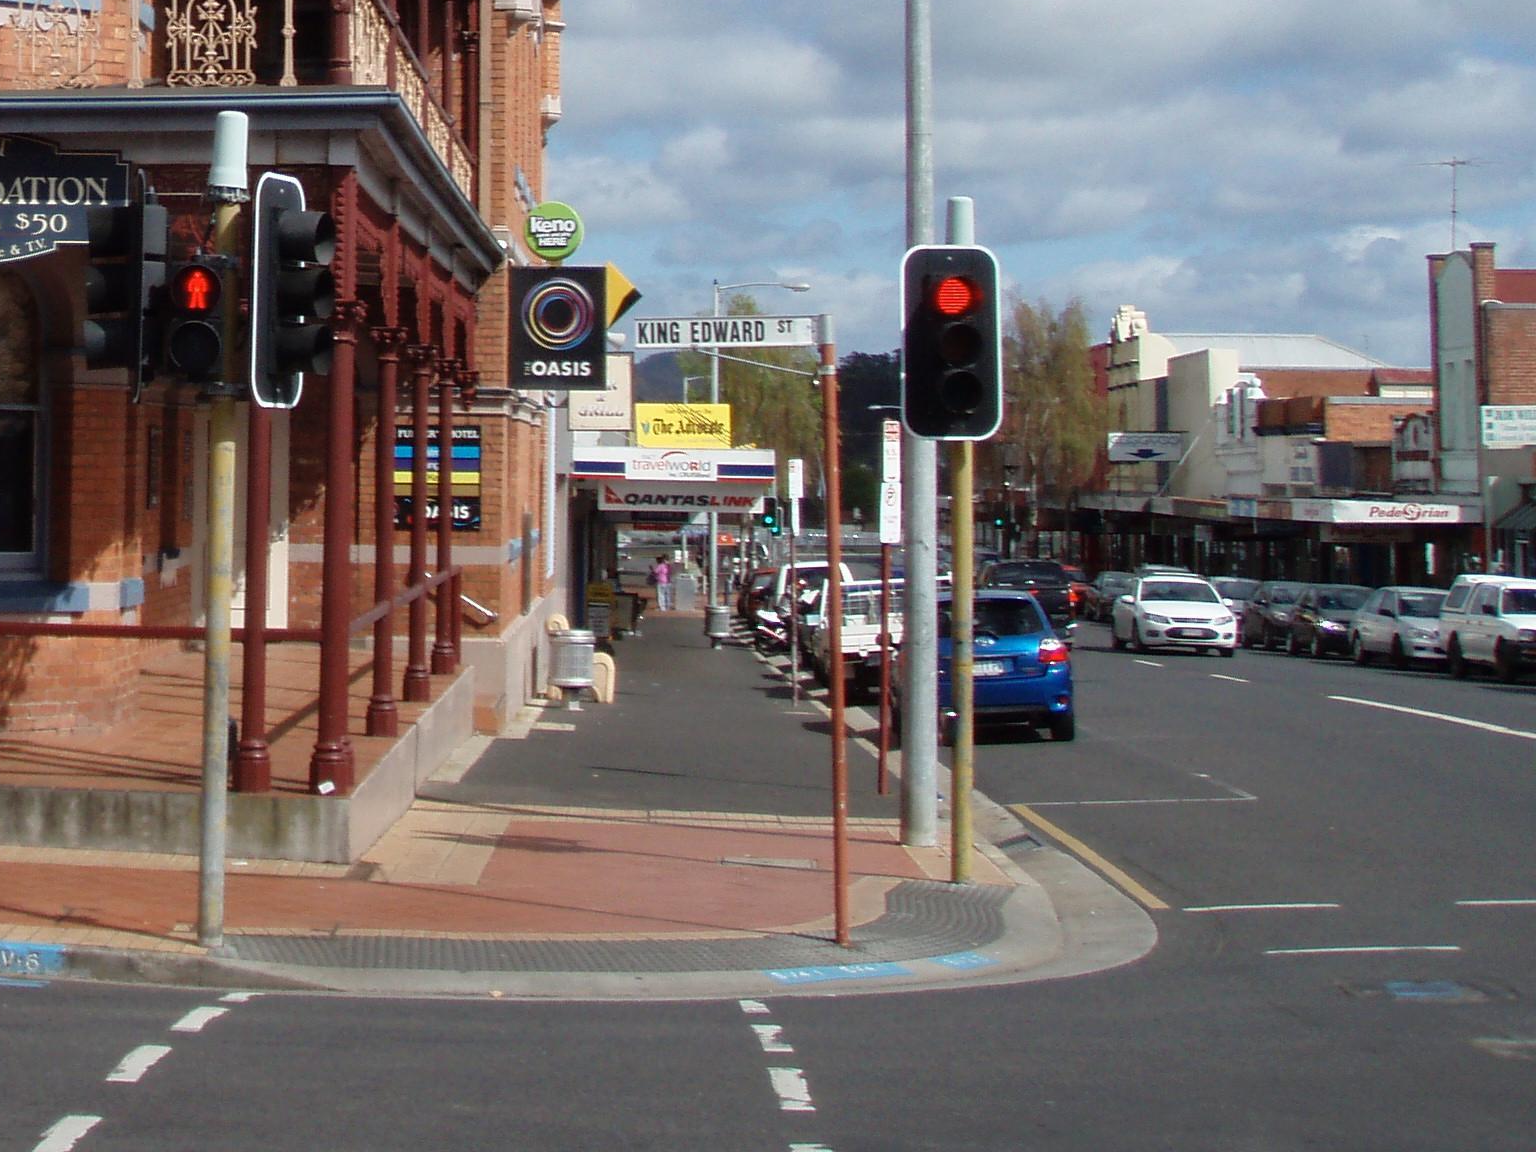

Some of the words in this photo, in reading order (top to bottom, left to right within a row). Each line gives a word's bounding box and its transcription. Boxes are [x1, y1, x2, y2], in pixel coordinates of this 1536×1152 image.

[15, 212, 69, 236] $50
[10, 244, 21, 256] &
[637, 321, 680, 344] KING
[690, 320, 765, 343] EDWARD
[777, 319, 793, 334] ST
[531, 360, 592, 377] OASIS
